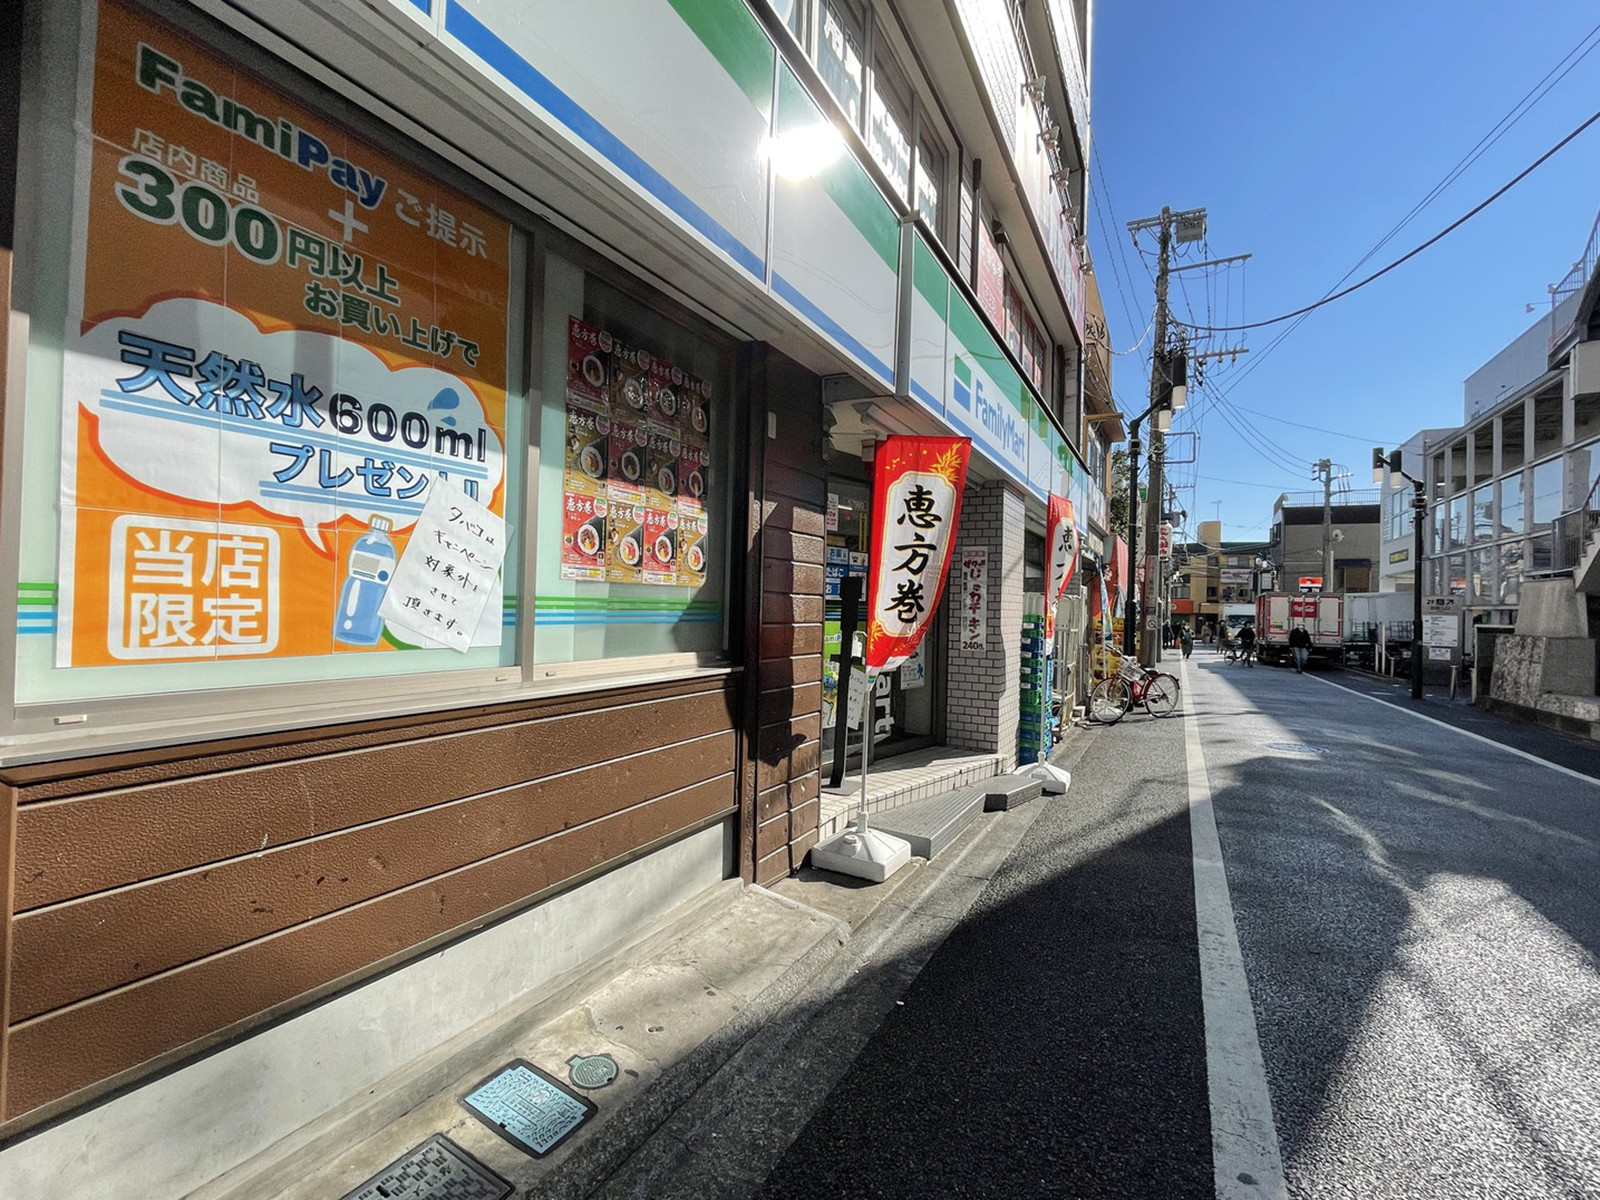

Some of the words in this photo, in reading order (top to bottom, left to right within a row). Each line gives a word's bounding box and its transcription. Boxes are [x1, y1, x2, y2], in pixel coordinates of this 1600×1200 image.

[133, 128, 260, 203] 店内商品
[137, 42, 388, 209] FamiPay
[394, 188, 488, 260] ご提示
[303, 282, 480, 368] お買い上げで
[976, 378, 1025, 463] FamilyMart
[448, 506, 495, 546] タバコは
[566, 497, 592, 515] 恵方巻
[132, 529, 264, 589] 当店
[884, 485, 942, 624] 恵方巻
[130, 592, 263, 646] 限定
[430, 586, 457, 606] させて
